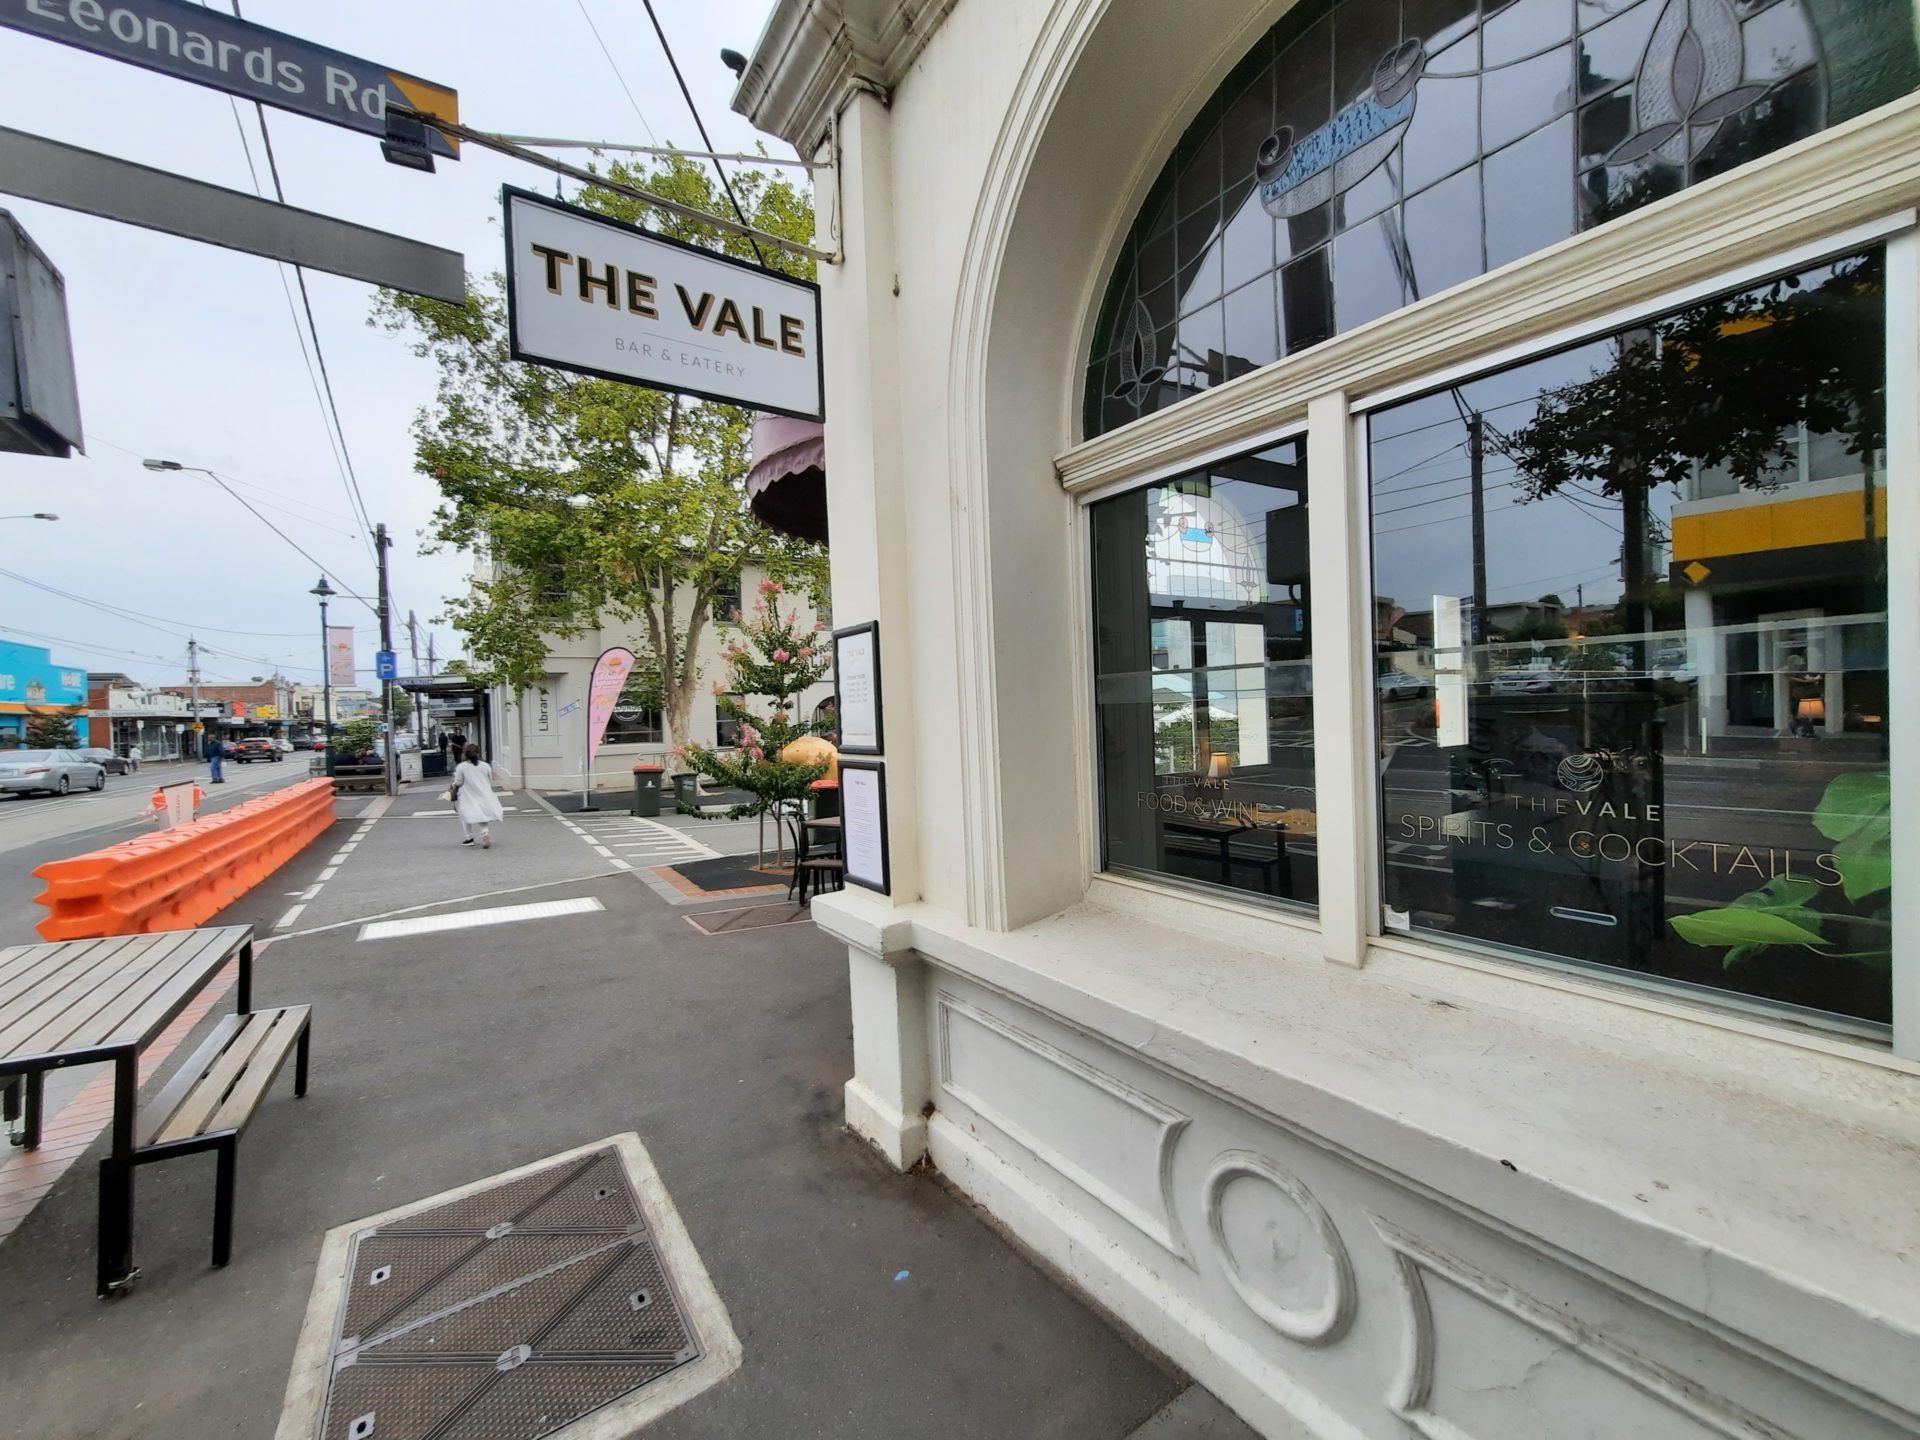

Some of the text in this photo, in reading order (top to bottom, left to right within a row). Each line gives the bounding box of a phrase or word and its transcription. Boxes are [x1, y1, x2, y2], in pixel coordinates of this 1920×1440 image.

[325, 65, 386, 121] Rd
[530, 241, 806, 358] THE VALE
[615, 337, 745, 377] BAR & EATERY
[381, 664, 393, 676] P
[538, 689, 549, 732] Librar
[1137, 791, 1263, 822] FOOD & WINE
[1400, 814, 1843, 886] SPIRITS & COCKTAILS
